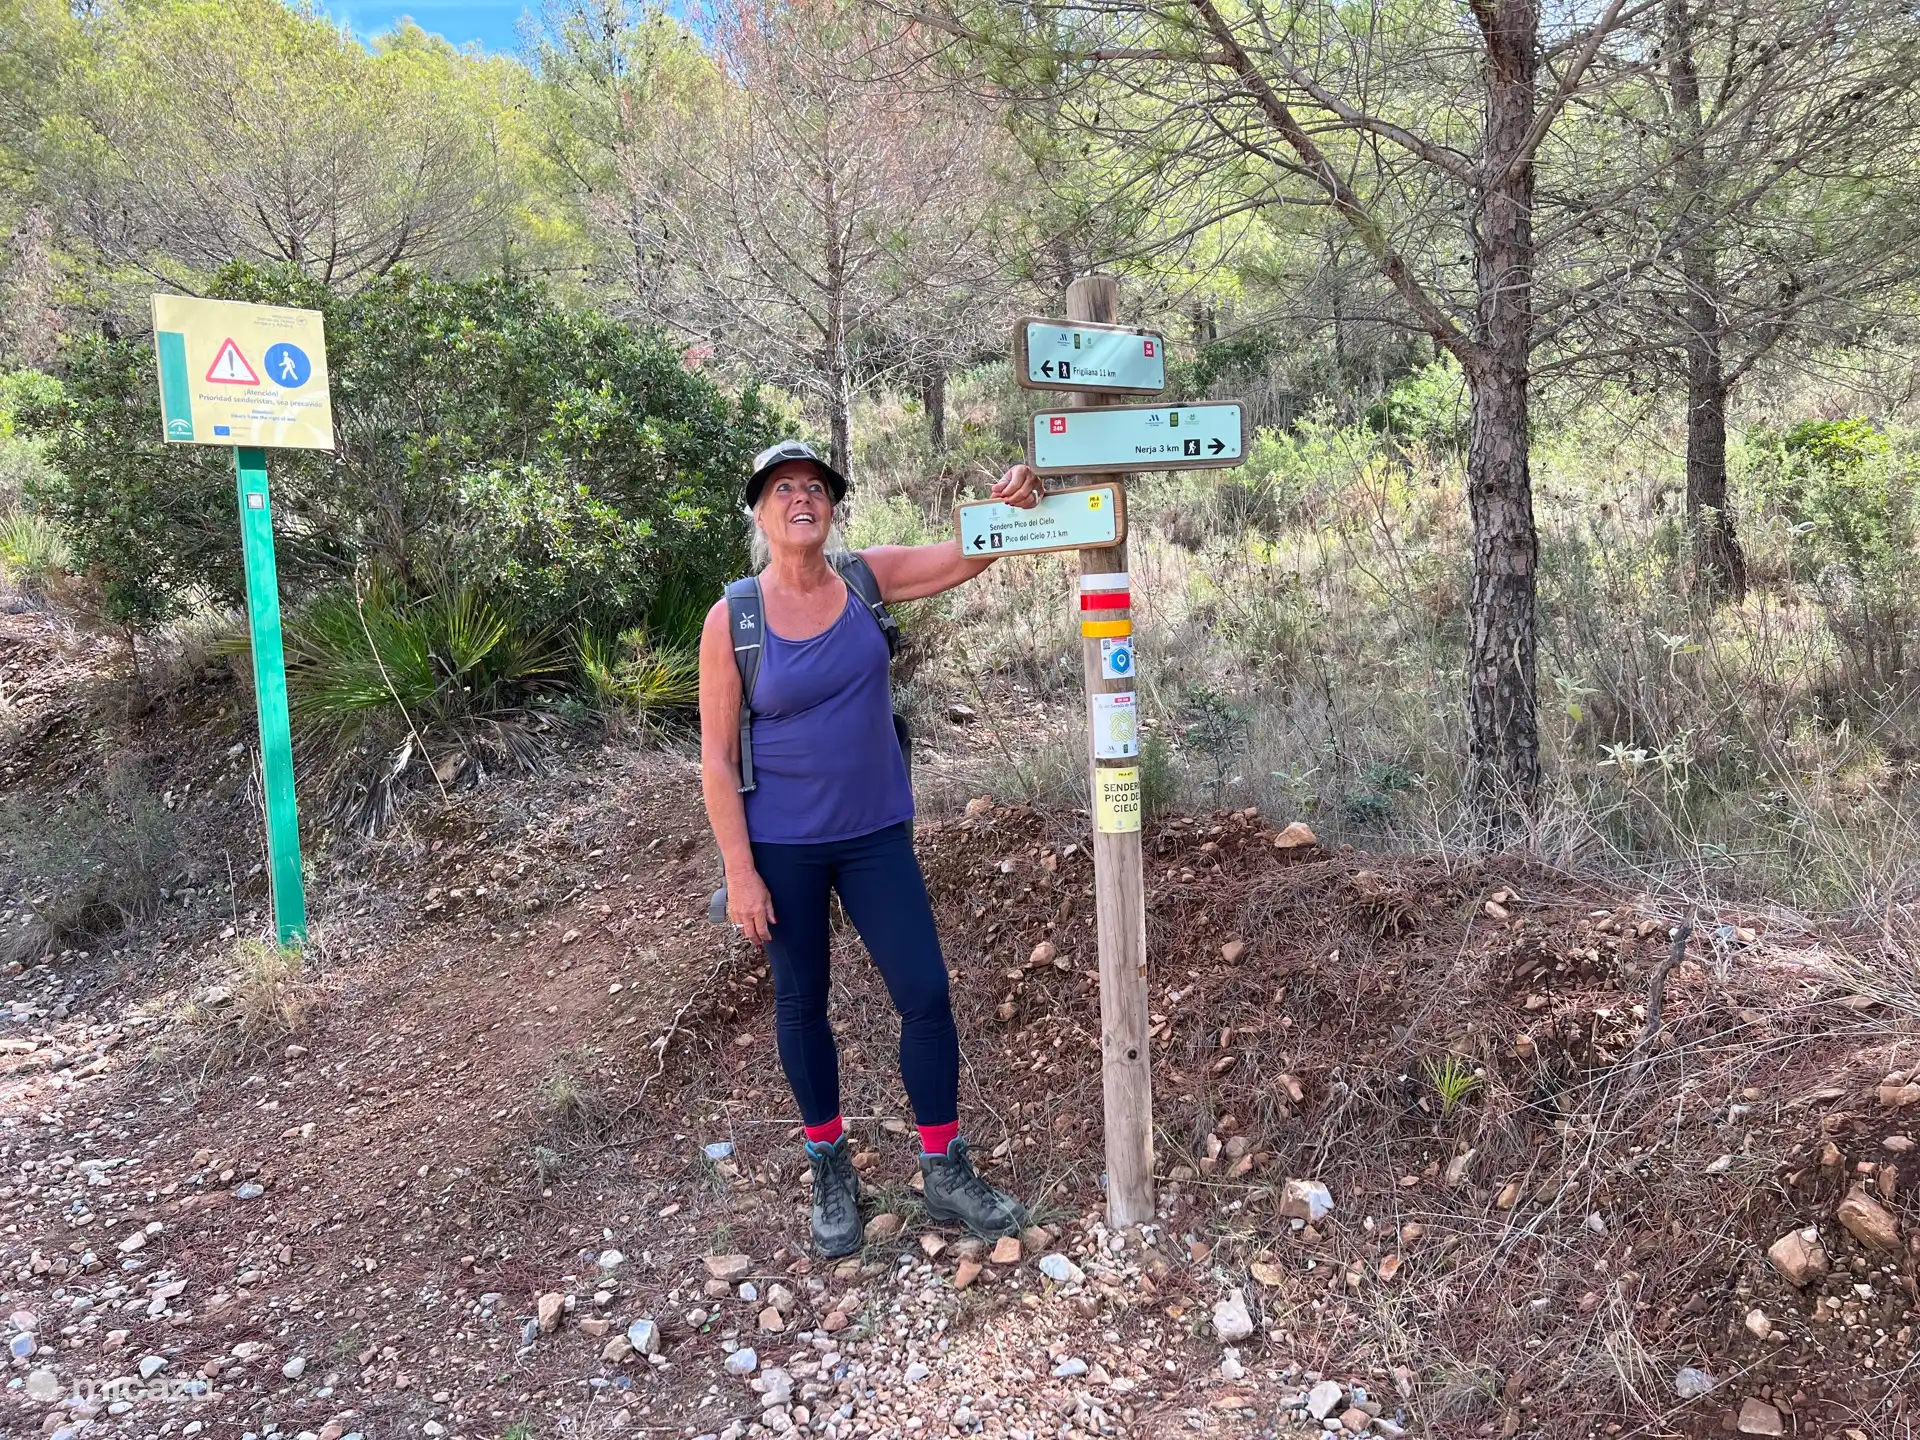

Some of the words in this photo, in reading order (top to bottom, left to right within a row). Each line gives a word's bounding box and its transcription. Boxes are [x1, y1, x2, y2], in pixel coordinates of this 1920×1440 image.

[1073, 366, 1098, 377] Frigiliana
[1099, 368, 1106, 377] 11
[1107, 369, 1116, 377] km
[198, 393, 232, 402] Prioridad
[1135, 445, 1157, 455] Nerja
[1159, 444, 1165, 453] 3
[1166, 444, 1180, 452] km
[989, 523, 1013, 531] Sendero
[1014, 520, 1028, 529] Pico
[1028, 518, 1038, 527] del
[1039, 517, 1055, 526] Cielo
[1005, 535, 1019, 543] Pico
[1019, 533, 1029, 542] del
[1029, 531, 1046, 541] Cielo
[1046, 530, 1057, 539] 7,1
[1057, 529, 1068, 537] km
[1103, 782, 1140, 792] SENDER
[1104, 793, 1128, 802] PICO
[1130, 792, 1140, 802] DE
[1113, 802, 1138, 813] CIELO
